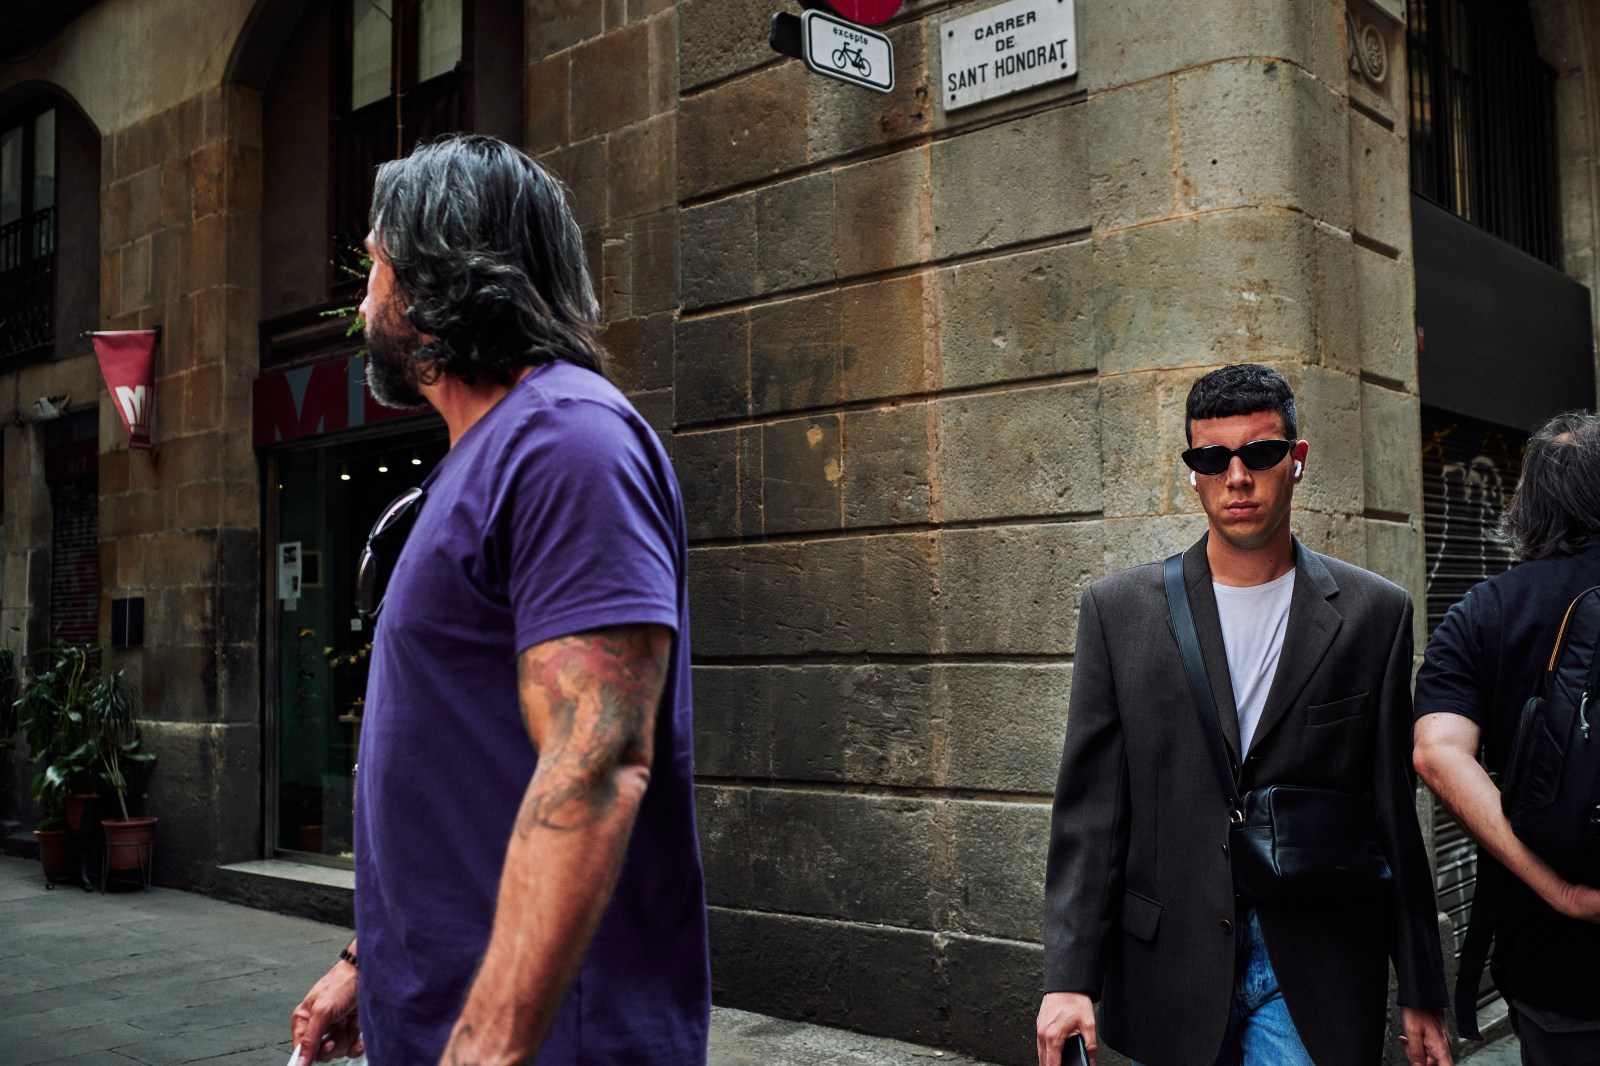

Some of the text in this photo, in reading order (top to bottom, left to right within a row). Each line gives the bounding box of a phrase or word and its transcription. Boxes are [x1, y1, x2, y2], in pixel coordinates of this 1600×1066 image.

[833, 26, 869, 45] excepte
[974, 10, 1037, 40] CARRER
[995, 35, 1016, 53] DE
[947, 39, 1068, 92] SANT HONORAT
